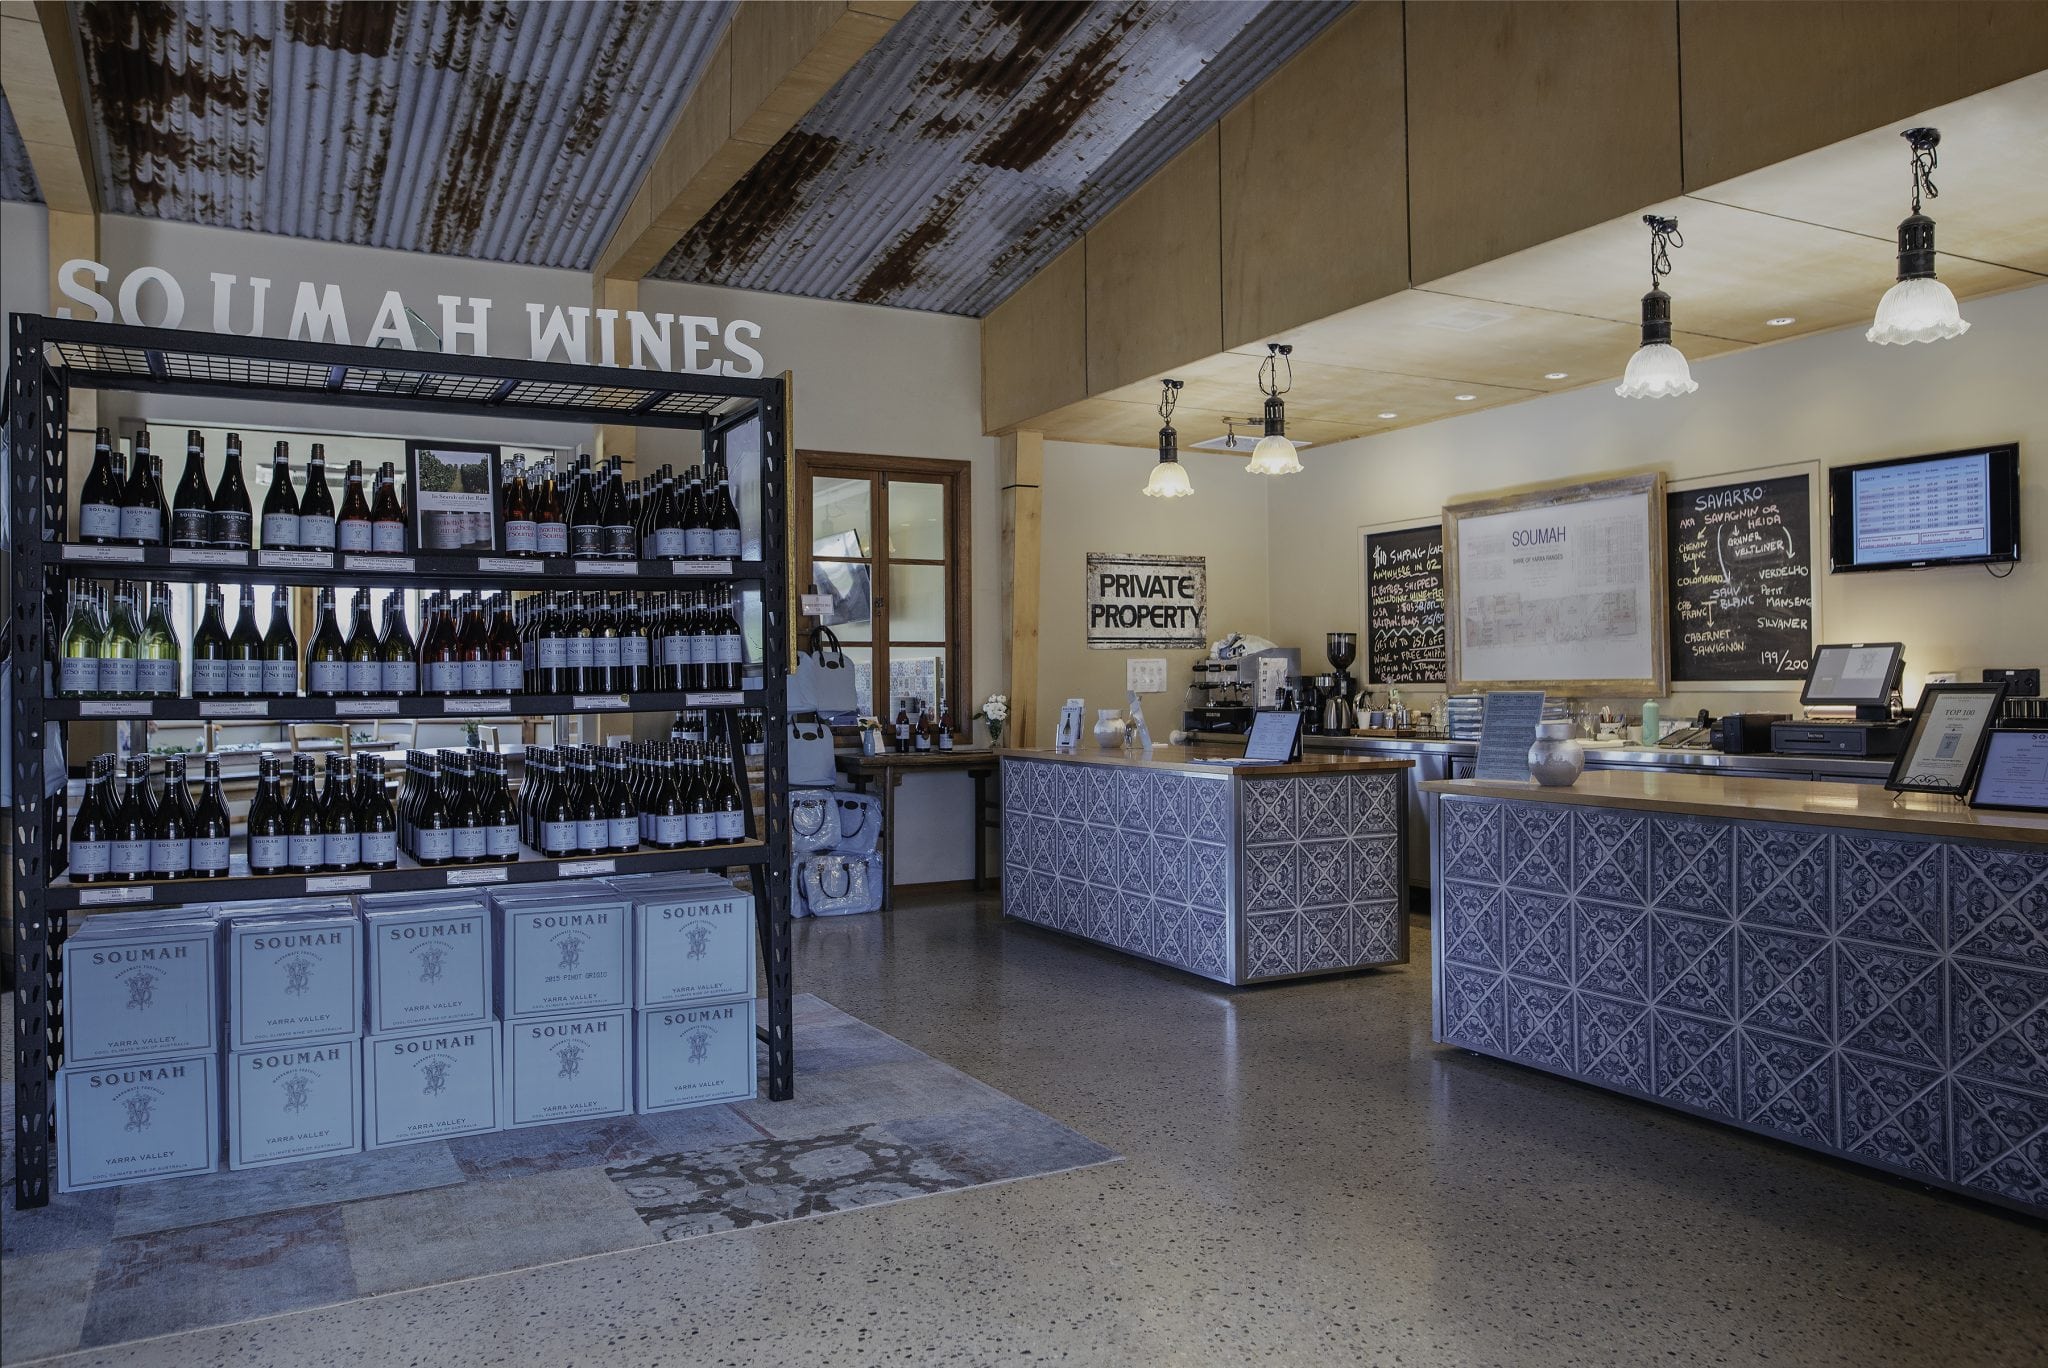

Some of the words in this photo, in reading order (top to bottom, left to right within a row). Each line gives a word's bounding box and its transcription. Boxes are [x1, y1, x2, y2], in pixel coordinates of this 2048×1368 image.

[56, 259, 492, 357] SOUMAH
[526, 302, 764, 379] WINES
[1695, 487, 1763, 511] SAVARRO
[1704, 506, 1759, 524] SAVAGNIN
[1763, 504, 1779, 514] OR
[1748, 515, 1781, 529] HEIDA
[1512, 526, 1566, 547] SOUMAH
[1735, 540, 1784, 557] VELTLINER
[1682, 551, 1706, 562] BLANC
[1415, 562, 1423, 571] IN
[1759, 566, 1808, 579] VERDELHO
[1100, 573, 1195, 599] PRIVATE
[1720, 595, 1754, 610] BLANC
[1090, 604, 1205, 629] PROPERTY
[1681, 607, 1707, 620] FRANC
[1757, 617, 1808, 630] SILVANER
[1389, 636, 1398, 648] UP
[1684, 629, 1731, 643] CABERNET
[1401, 651, 1421, 660] FREE
[1692, 641, 1744, 656] SAUVIGNON
[663, 903, 733, 919] SOUMAH
[532, 913, 607, 929] SOUMAH
[390, 922, 472, 940] SOUMAH
[254, 932, 341, 950] SOUMAH
[92, 946, 187, 965] SOUMAH
[697, 982, 723, 990] VALLEY
[570, 993, 598, 1001] VALLEY
[432, 1001, 463, 1009] VALLEY
[267, 1018, 296, 1026] YARRA
[298, 1014, 330, 1023] VALLEY
[664, 1008, 733, 1025] SOUMAH
[532, 1021, 607, 1039] SOUMAH
[108, 1040, 138, 1048] YARRA
[142, 1036, 176, 1044] VALLEY
[394, 1035, 474, 1055] SOUMAH
[252, 1048, 339, 1070] SOUMAH
[90, 1066, 185, 1088] SOUMAH
[674, 1083, 697, 1091] YARRA
[699, 1080, 725, 1088] VALLEY
[570, 1101, 597, 1109] VALLEY
[408, 1123, 434, 1131] YARRA
[436, 1118, 466, 1127] VALLEY
[266, 1135, 295, 1144] YARRA
[297, 1130, 330, 1139] VALLEY
[105, 1156, 137, 1165] YARRA
[140, 1151, 175, 1160] VALLEY
